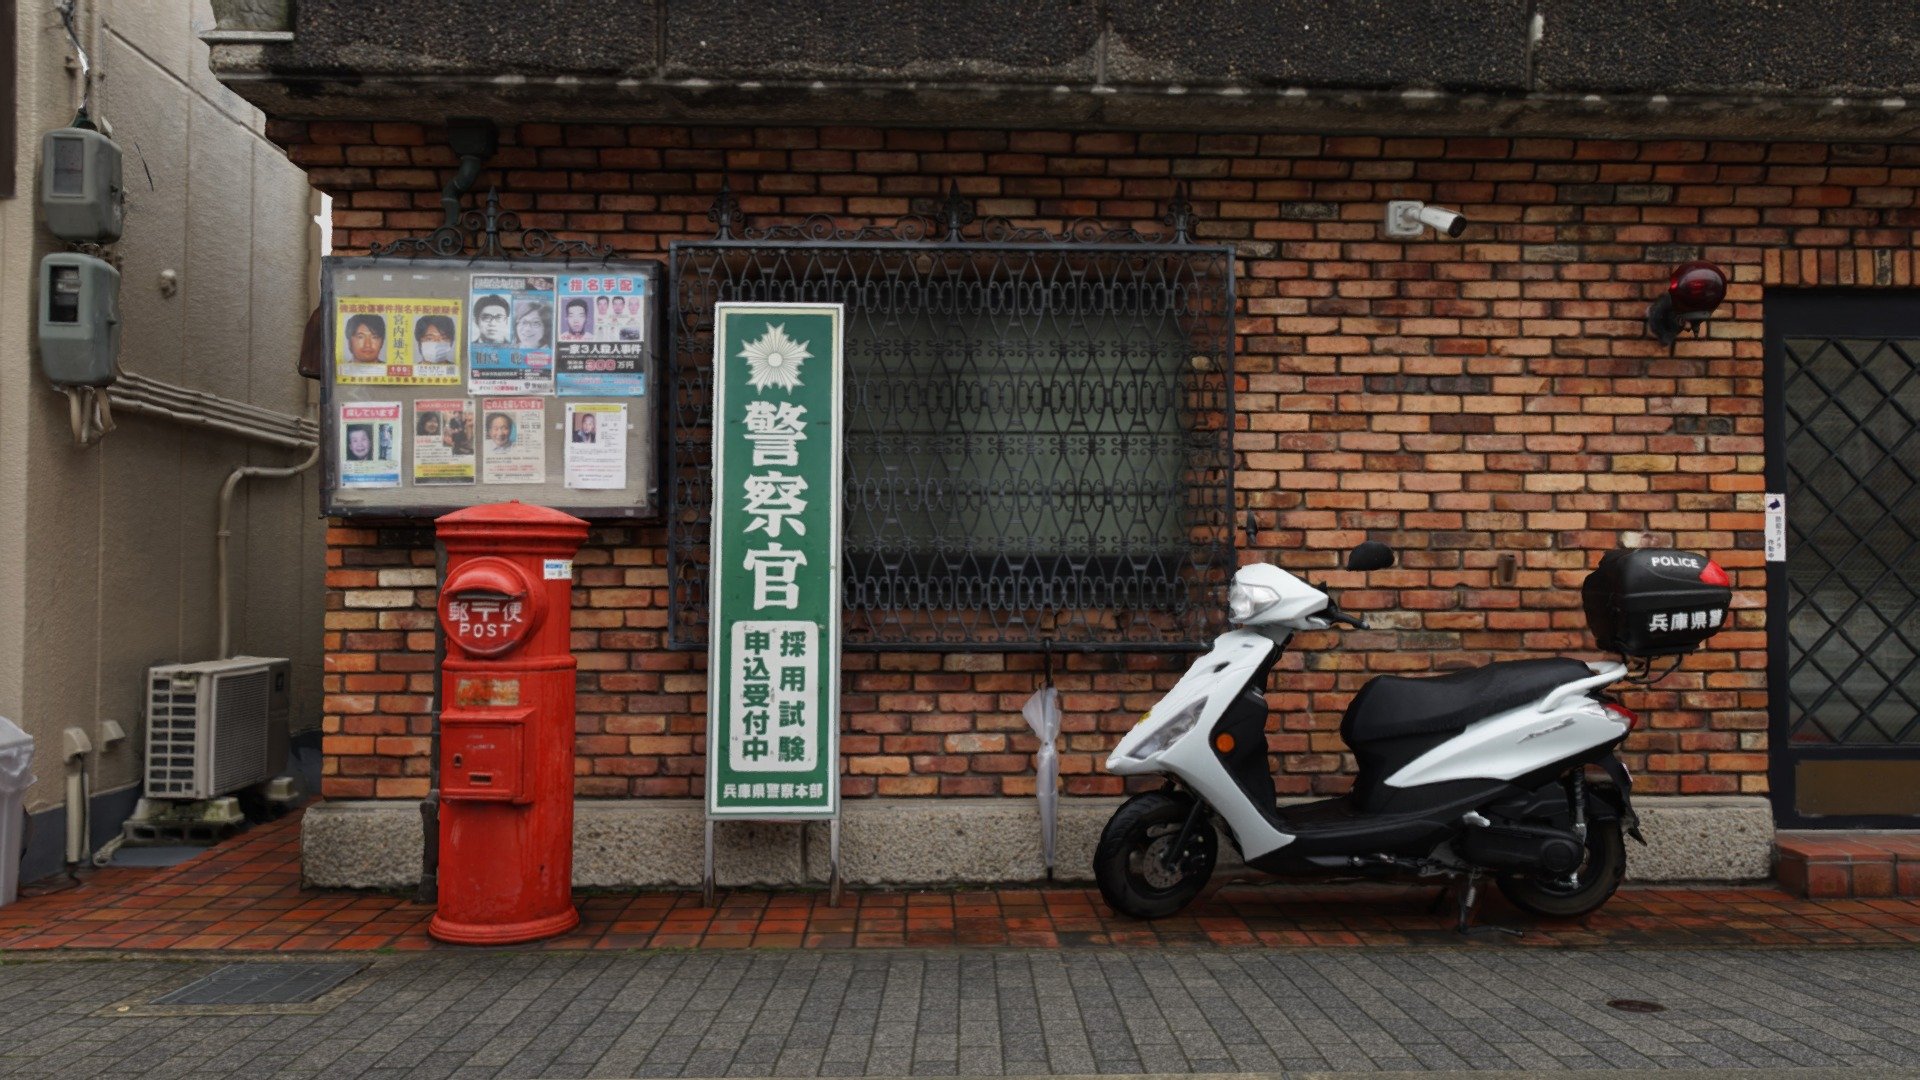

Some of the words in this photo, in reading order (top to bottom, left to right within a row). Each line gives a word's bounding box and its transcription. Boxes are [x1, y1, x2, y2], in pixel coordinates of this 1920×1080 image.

[570, 279, 632, 291] 指名手配
[743, 401, 808, 610] 警察官
[1651, 556, 1700, 569] POLICE
[1649, 608, 1723, 632] 兵庫県警
[459, 623, 511, 638] POST
[742, 630, 770, 762] 申込受付中
[778, 630, 806, 762] 採用試験
[723, 783, 824, 799] 兵庫県警察本部
